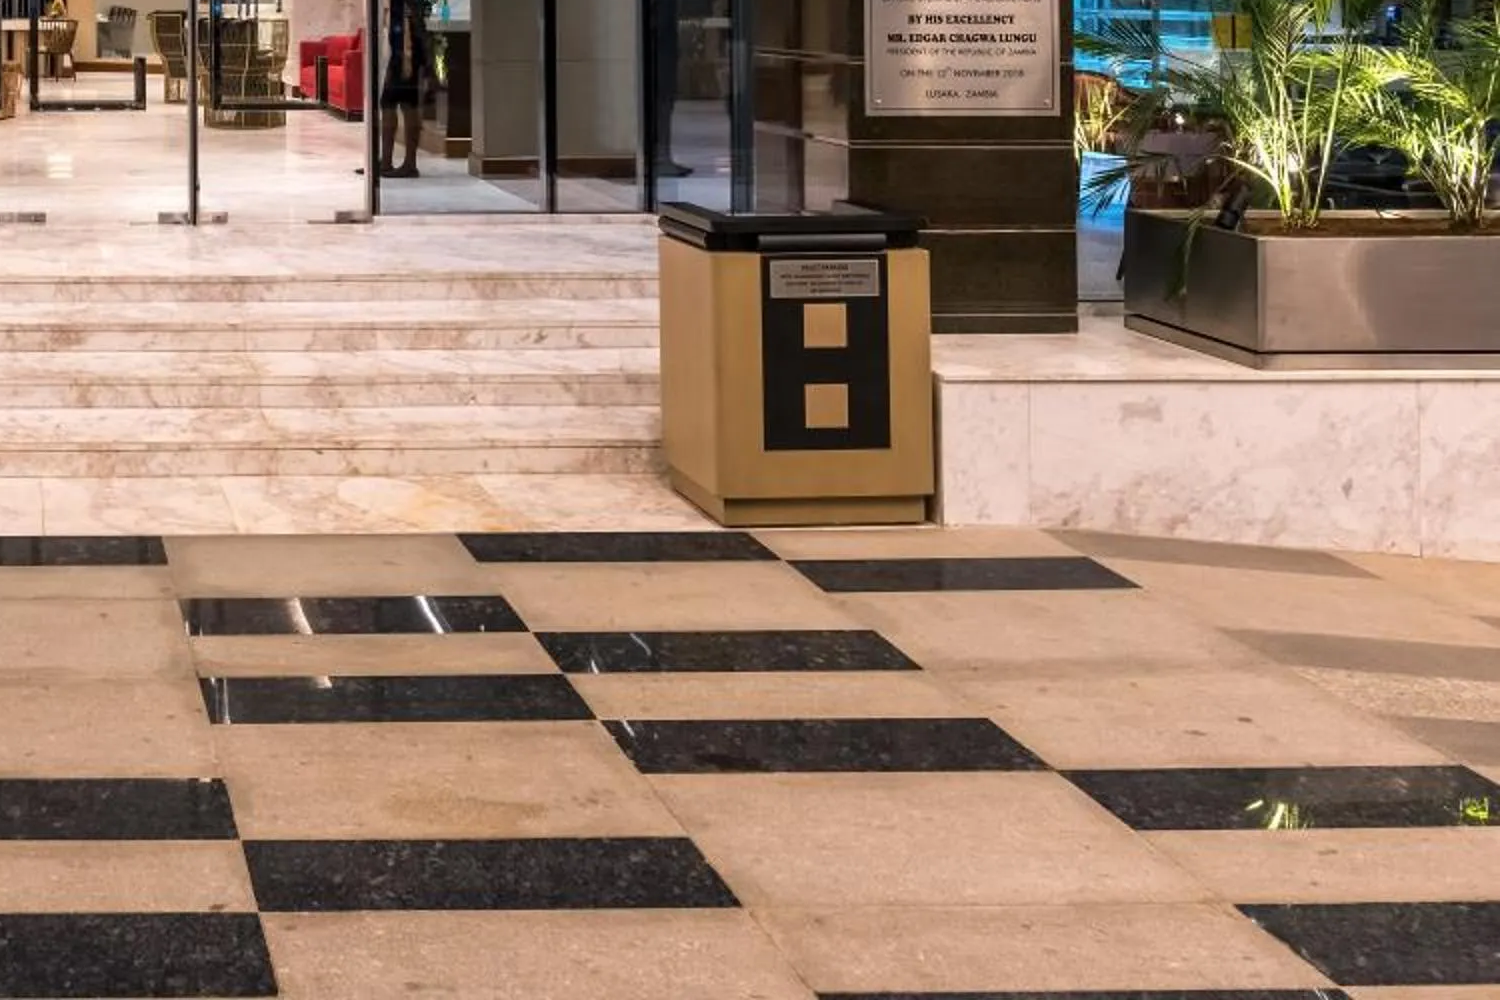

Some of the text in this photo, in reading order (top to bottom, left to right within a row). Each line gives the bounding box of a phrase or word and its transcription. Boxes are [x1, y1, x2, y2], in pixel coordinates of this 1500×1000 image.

[907, 15, 1014, 25] BY HIS EXCELLENCY
[887, 33, 1037, 43] MR. EDGAR CHAGWA LUNGU
[930, 48, 940, 56] OF
[995, 48, 1005, 56] OF
[899, 69, 915, 78] ON
